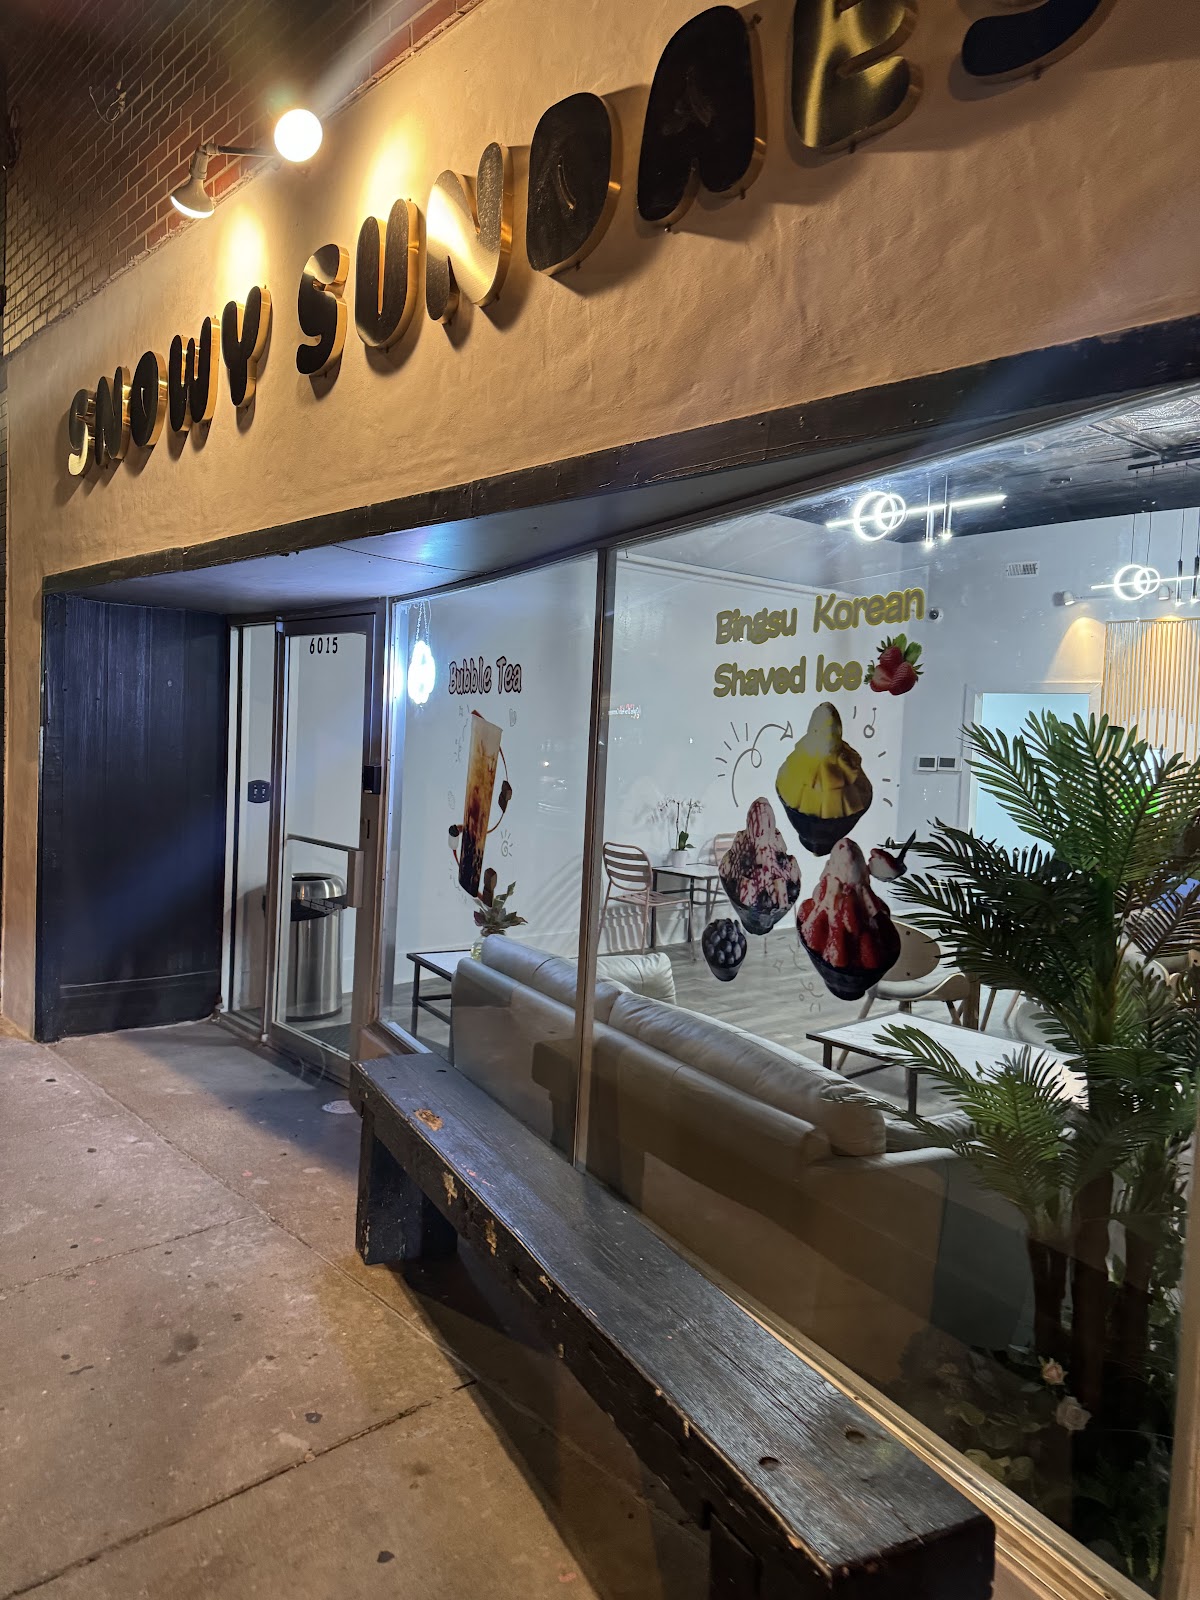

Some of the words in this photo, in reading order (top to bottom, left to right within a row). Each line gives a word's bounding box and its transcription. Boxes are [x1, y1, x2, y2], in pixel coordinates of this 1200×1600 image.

[68, 285, 272, 476] SNOWY
[296, 0, 1110, 376] SUNDAE
[715, 607, 798, 645] Bingsu
[812, 587, 925, 633] Korean
[309, 636, 338, 655] 6015
[448, 655, 492, 695] Bubble
[495, 655, 522, 695] Tea
[713, 655, 807, 698] Shaved
[815, 654, 863, 693] Ice
